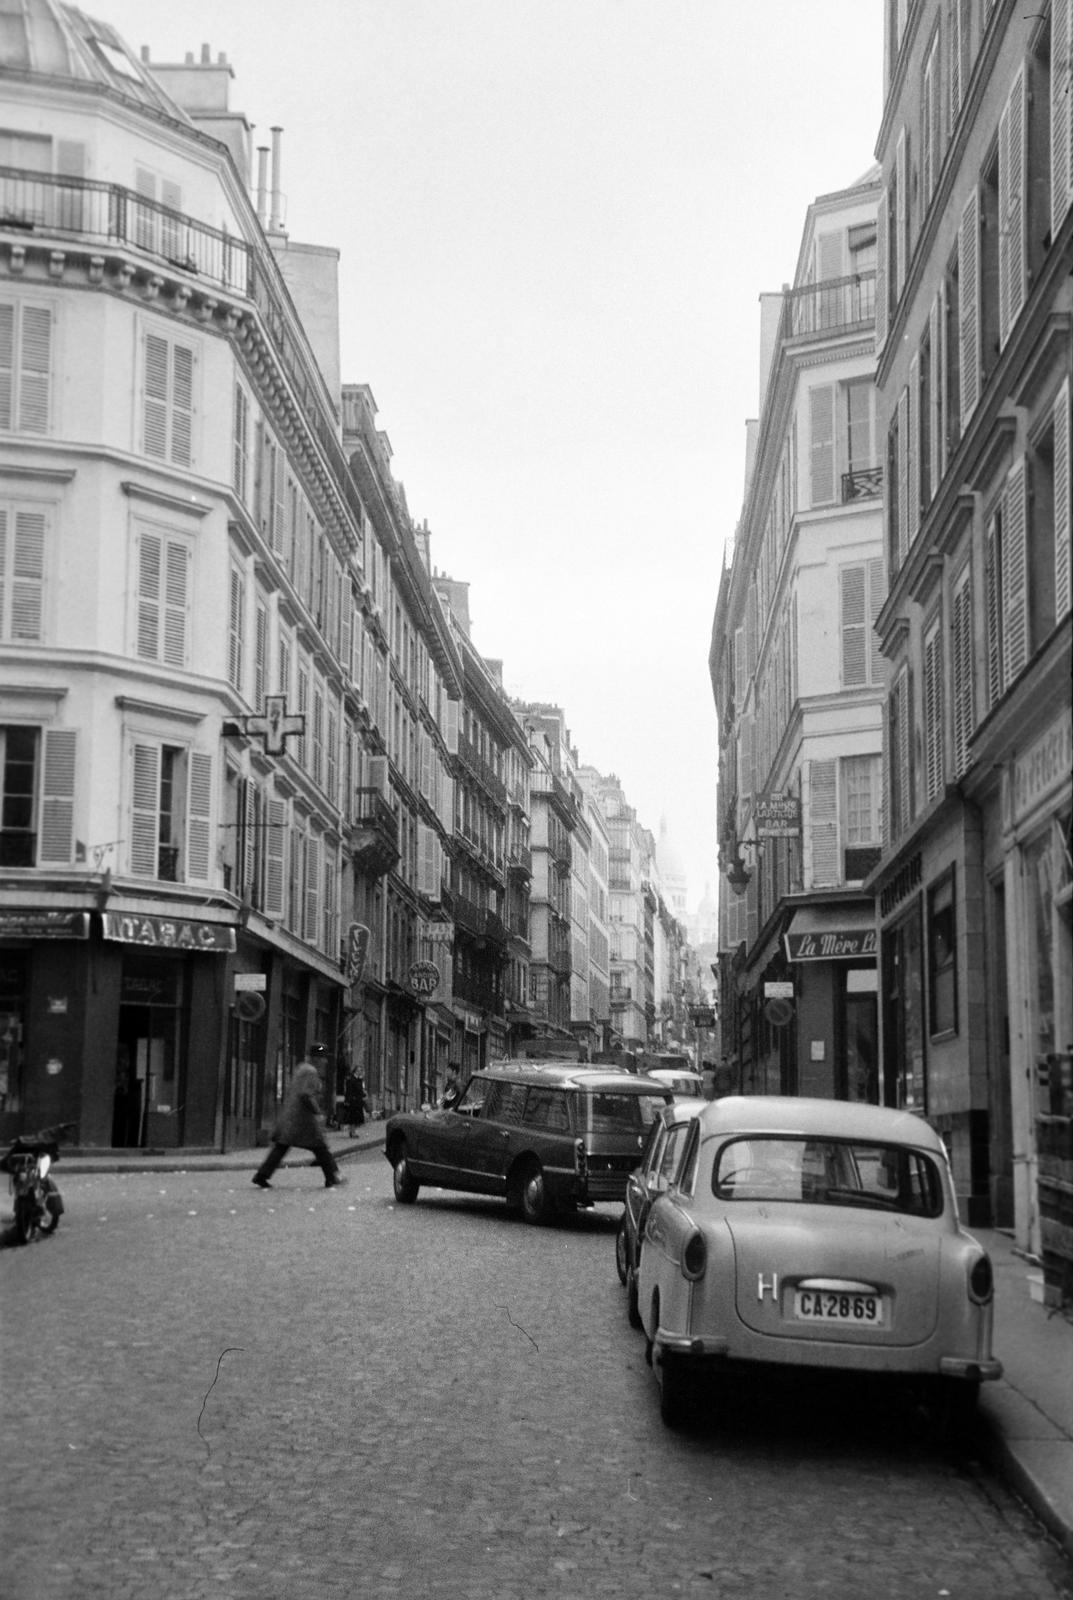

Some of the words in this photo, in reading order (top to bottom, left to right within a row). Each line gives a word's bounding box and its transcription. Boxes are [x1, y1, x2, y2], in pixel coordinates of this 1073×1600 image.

[121, 917, 214, 945] TABAC
[796, 934, 817, 956] La
[821, 933, 858, 954] Mère
[410, 978, 437, 992] BAR
[758, 1272, 778, 1300] H
